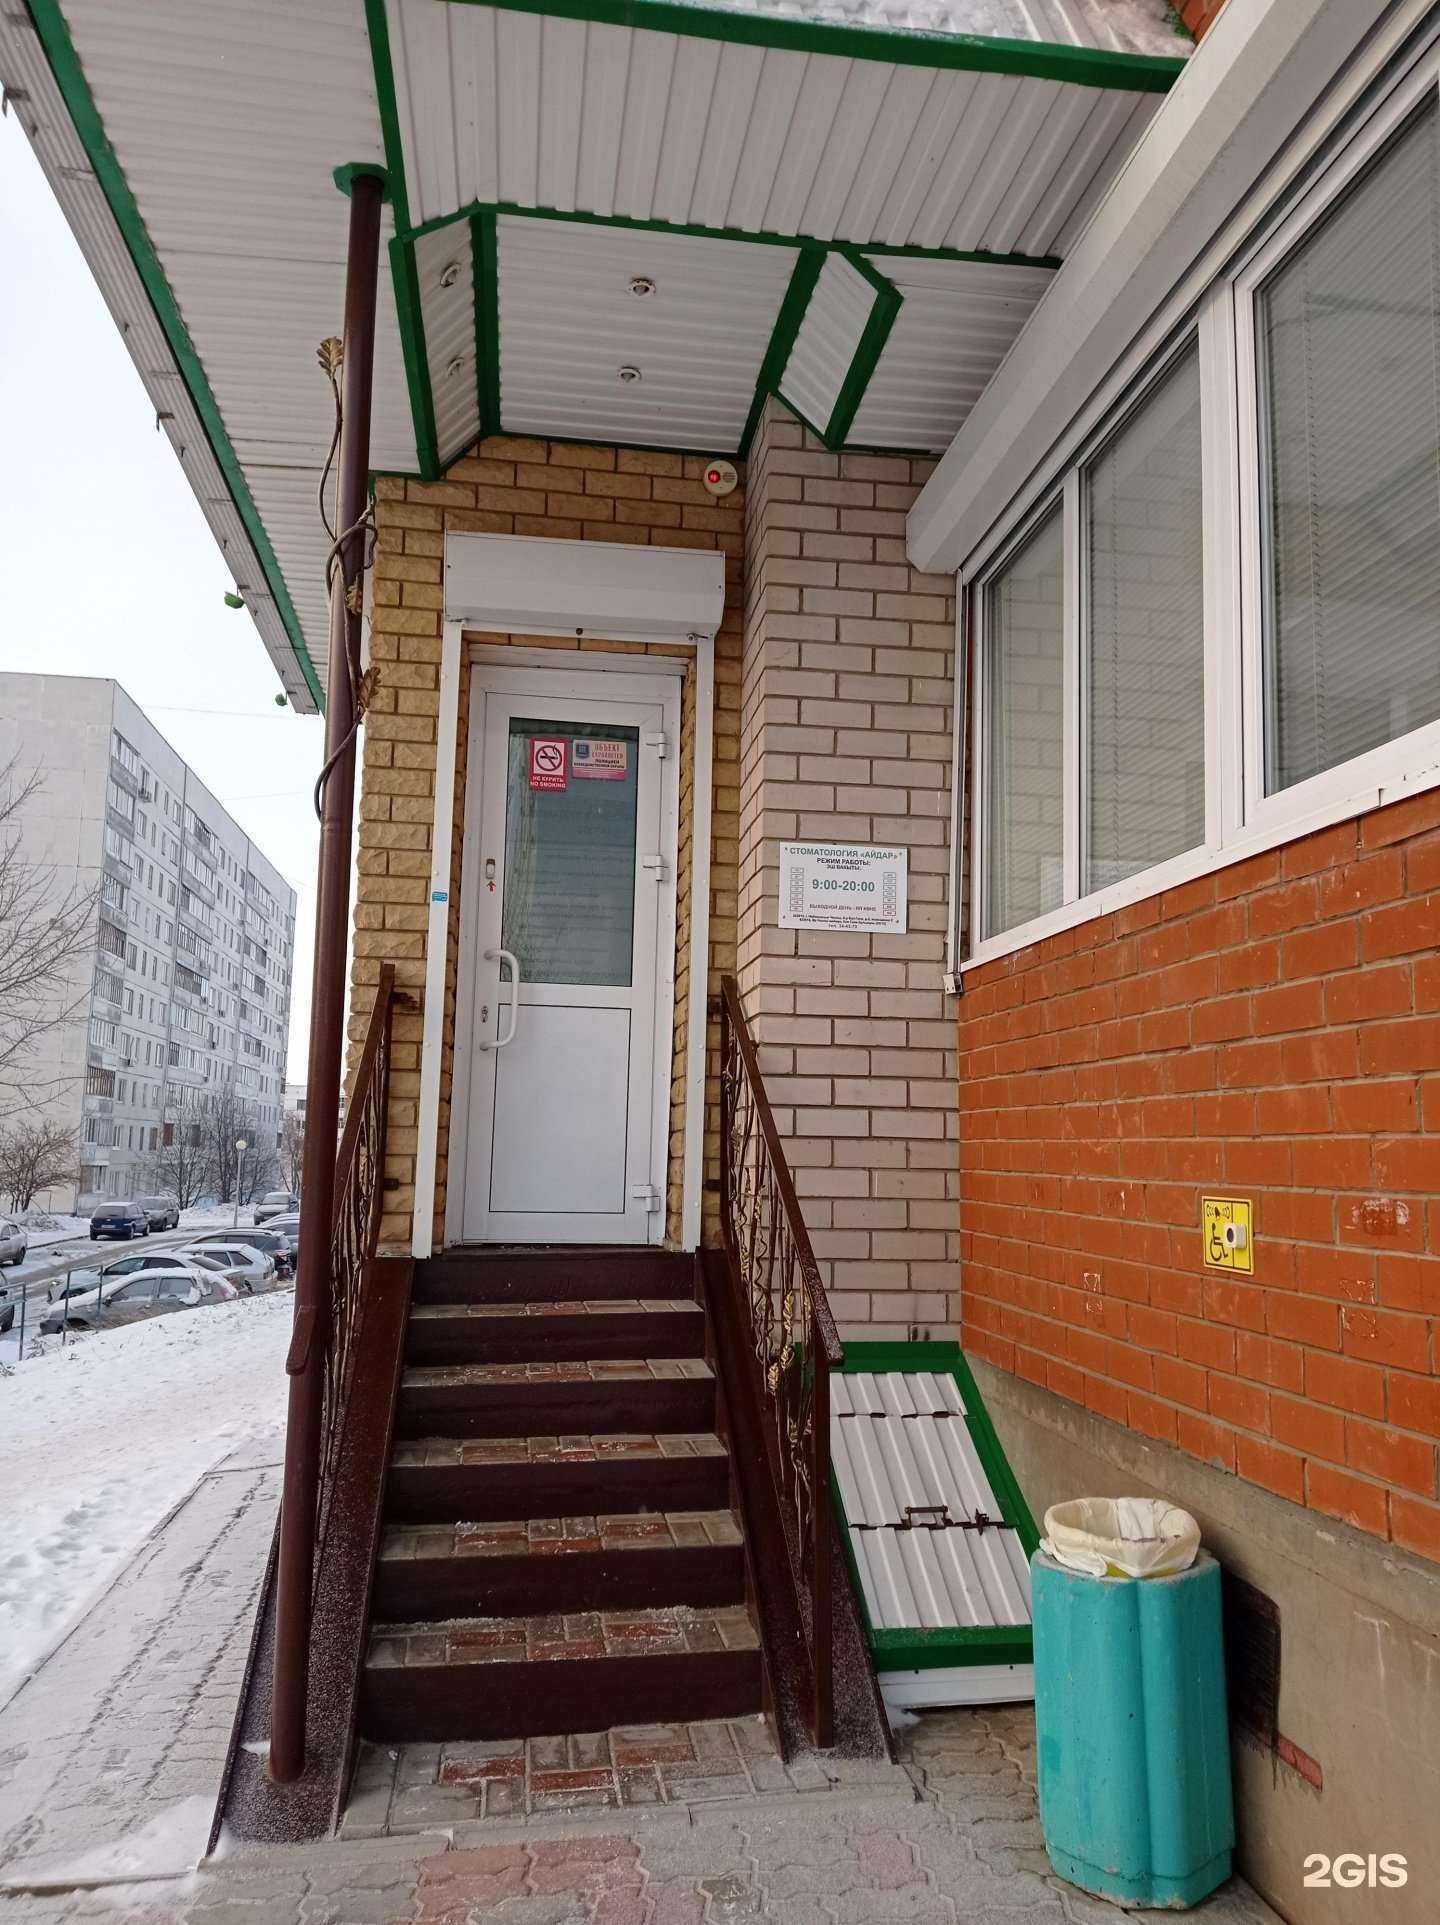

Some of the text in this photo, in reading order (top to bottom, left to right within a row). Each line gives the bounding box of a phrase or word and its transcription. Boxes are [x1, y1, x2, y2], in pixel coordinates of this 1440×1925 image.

[539, 781, 566, 789] SMOKING
[790, 847, 898, 860] СТОМАТОЛОГИЯ «АЙДАР»
[816, 857, 871, 867] РЕЖИМ РАБОТЫ:
[812, 878, 875, 893] 9:00-20:00
